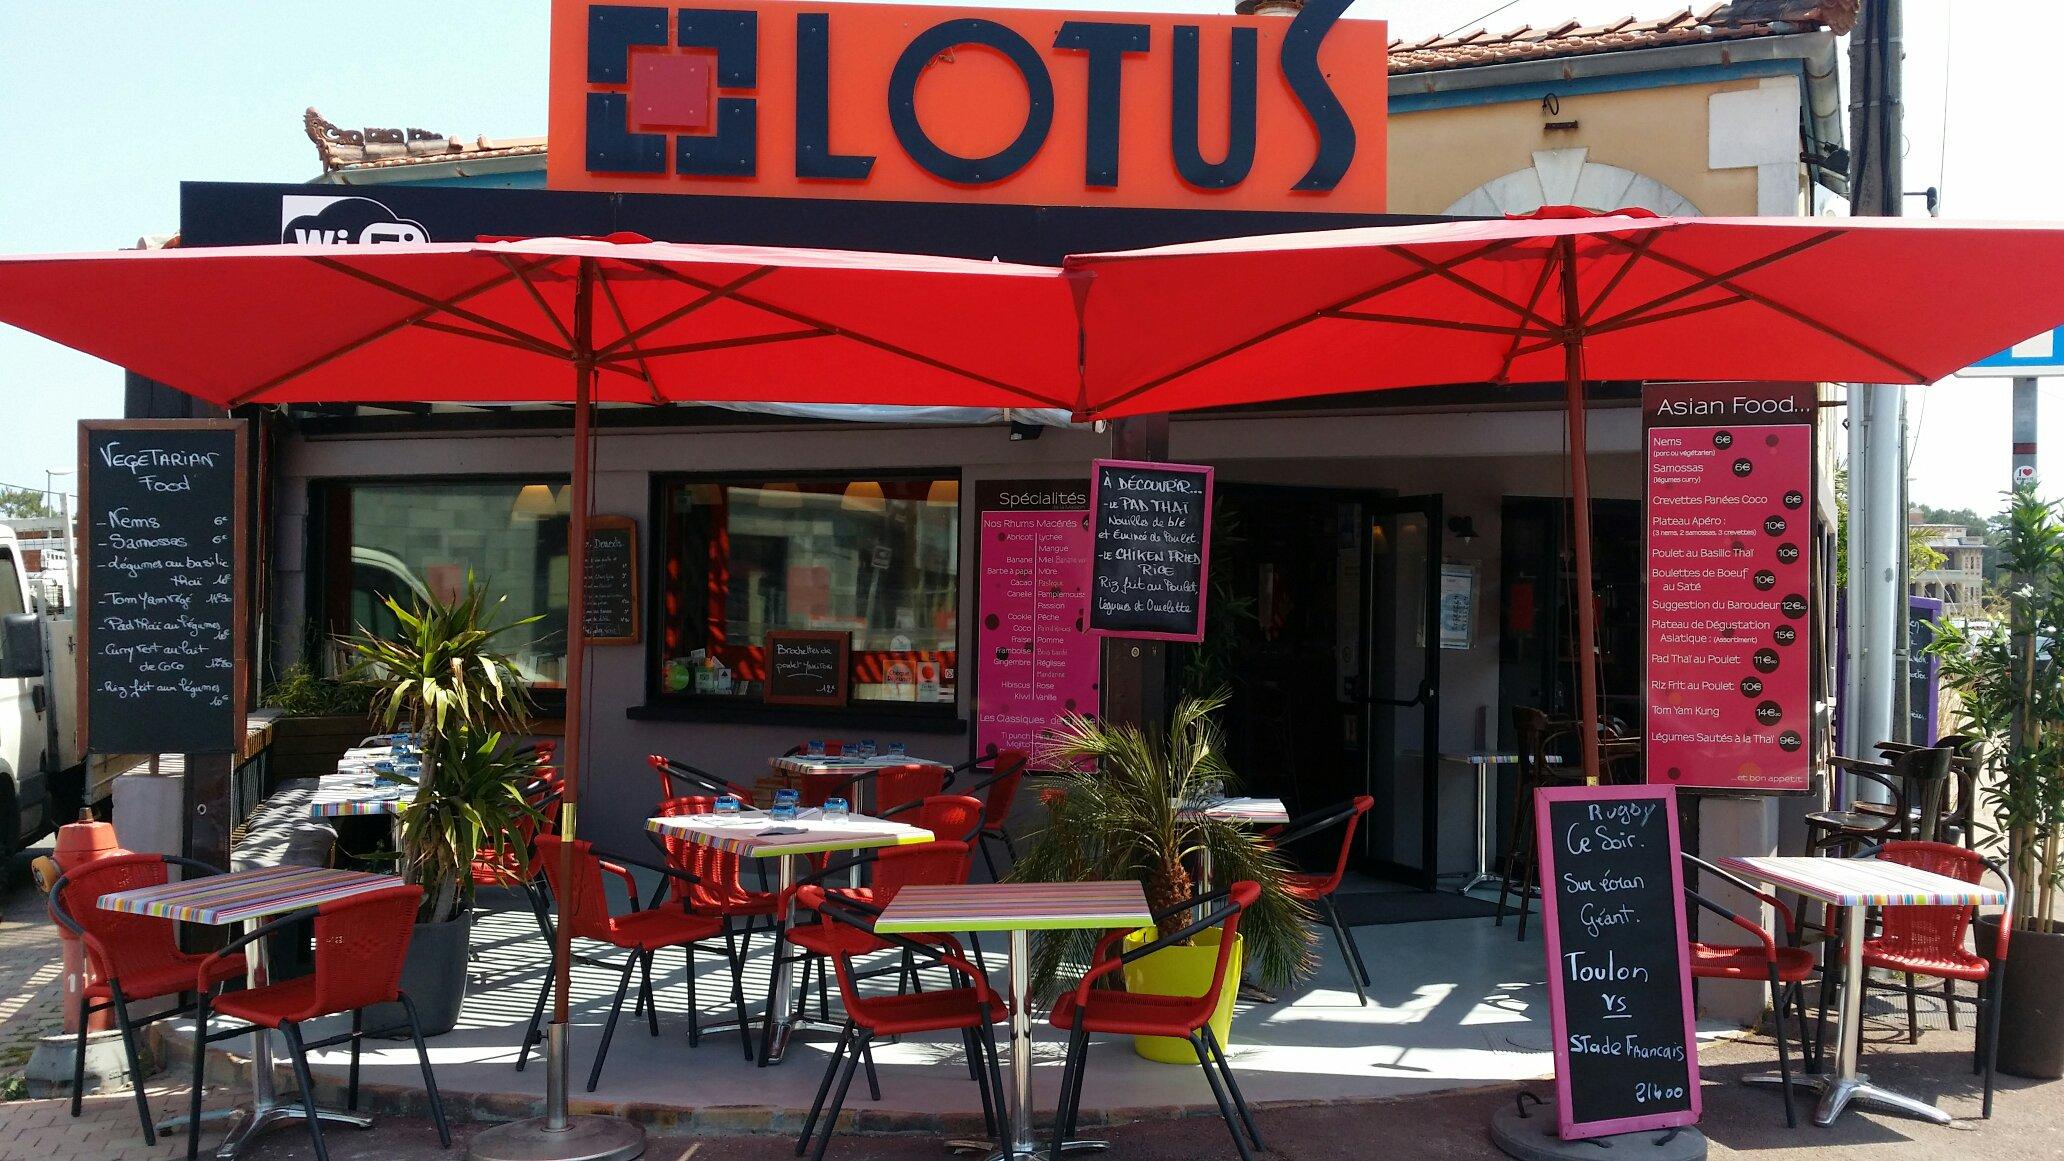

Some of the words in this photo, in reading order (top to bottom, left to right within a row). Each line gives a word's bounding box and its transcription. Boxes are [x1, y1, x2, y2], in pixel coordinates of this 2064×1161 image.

[795, 0, 1357, 192] LOTUS
[1657, 398, 1724, 416] Asian
[1734, 396, 1810, 414] Food...
[1654, 437, 1682, 446] Nems
[1715, 436, 1731, 444] 6€
[1654, 464, 1703, 473] Samossas
[1735, 463, 1750, 471] 6€
[138, 474, 190, 491] Food
[1104, 471, 1112, 489] À
[999, 492, 1086, 508] Spécialités
[1119, 497, 1149, 512] PAD
[1150, 500, 1189, 514] THAÏ
[1653, 496, 1702, 505] Crevettes
[1704, 495, 1740, 504] Panées
[1742, 495, 1768, 504] Coco
[1785, 496, 1801, 504] 6€
[108, 507, 160, 528] Nems
[984, 520, 1001, 528] Nos
[1004, 520, 1035, 528] Rhums
[1036, 520, 1078, 528] Macérés
[1108, 515, 1149, 527] Nouilles
[1153, 516, 1165, 528] de
[1653, 517, 1690, 526] Plateau
[1692, 516, 1722, 527] Apéro
[1765, 521, 1786, 530] 10€
[109, 534, 188, 549] Samossas
[1098, 529, 1109, 540] et
[1150, 531, 1161, 542] de
[1038, 545, 1069, 553] Mangue
[1115, 548, 1163, 562] CHIKEN
[1653, 549, 1686, 558] Poulet
[1700, 548, 1731, 558] Basilic
[1733, 548, 1755, 557] Thaï
[1779, 549, 1798, 557] 10€
[165, 560, 184, 568] au
[186, 553, 229, 568] basilic
[1653, 569, 1700, 578] Boulettes
[1702, 568, 1716, 578] de
[1717, 567, 1749, 579] Boeuf
[1755, 576, 1775, 584] 10€
[1099, 576, 1119, 592] Riz
[1148, 583, 1163, 591] au
[1677, 582, 1701, 591] Saté
[104, 592, 137, 604] Tom
[138, 592, 167, 610] Yam
[1147, 599, 1191, 613] Omelette
[1653, 600, 1710, 612] Suggestion
[1712, 601, 1725, 610] du
[1728, 601, 1781, 610] Baroudeur
[104, 617, 134, 631] Pad
[177, 614, 220, 636] légumes
[1652, 620, 1690, 629] Plateau
[1691, 620, 1704, 629] de
[1706, 620, 1770, 631] Dégustation
[1660, 634, 1707, 644] Asiatique
[1775, 630, 1795, 639] 15€
[105, 643, 134, 663] Curry
[1652, 654, 1669, 663] Pad
[1671, 654, 1692, 663] Thaï
[1694, 655, 1706, 663] au
[1708, 654, 1740, 664] Poulet
[140, 662, 156, 672] de
[104, 681, 127, 698] Riz
[179, 678, 220, 698] légumes
[1652, 681, 1666, 690] Riz
[1668, 681, 1687, 690] Frit
[1702, 682, 1734, 690] Poulet
[1742, 682, 1762, 691] 10€
[980, 714, 996, 722] Les
[997, 714, 1045, 724] Classiques
[1652, 706, 1671, 715] Tom
[1673, 707, 1693, 715] Yam
[1695, 707, 1720, 718] Kung
[1009, 732, 1031, 740] punch
[1652, 733, 1694, 742] Légumes
[1696, 733, 1732, 742] Sautés
[1735, 734, 1741, 742] à
[1743, 734, 1751, 743] la
[1753, 734, 1774, 744] Thaï
[1750, 774, 1766, 782] bon
[1588, 802, 1657, 827] Rugby
[1566, 822, 1592, 855] Ce
[1564, 873, 1596, 894] Sur
[1599, 868, 1645, 893] écran
[1564, 950, 1649, 983] Toulon
